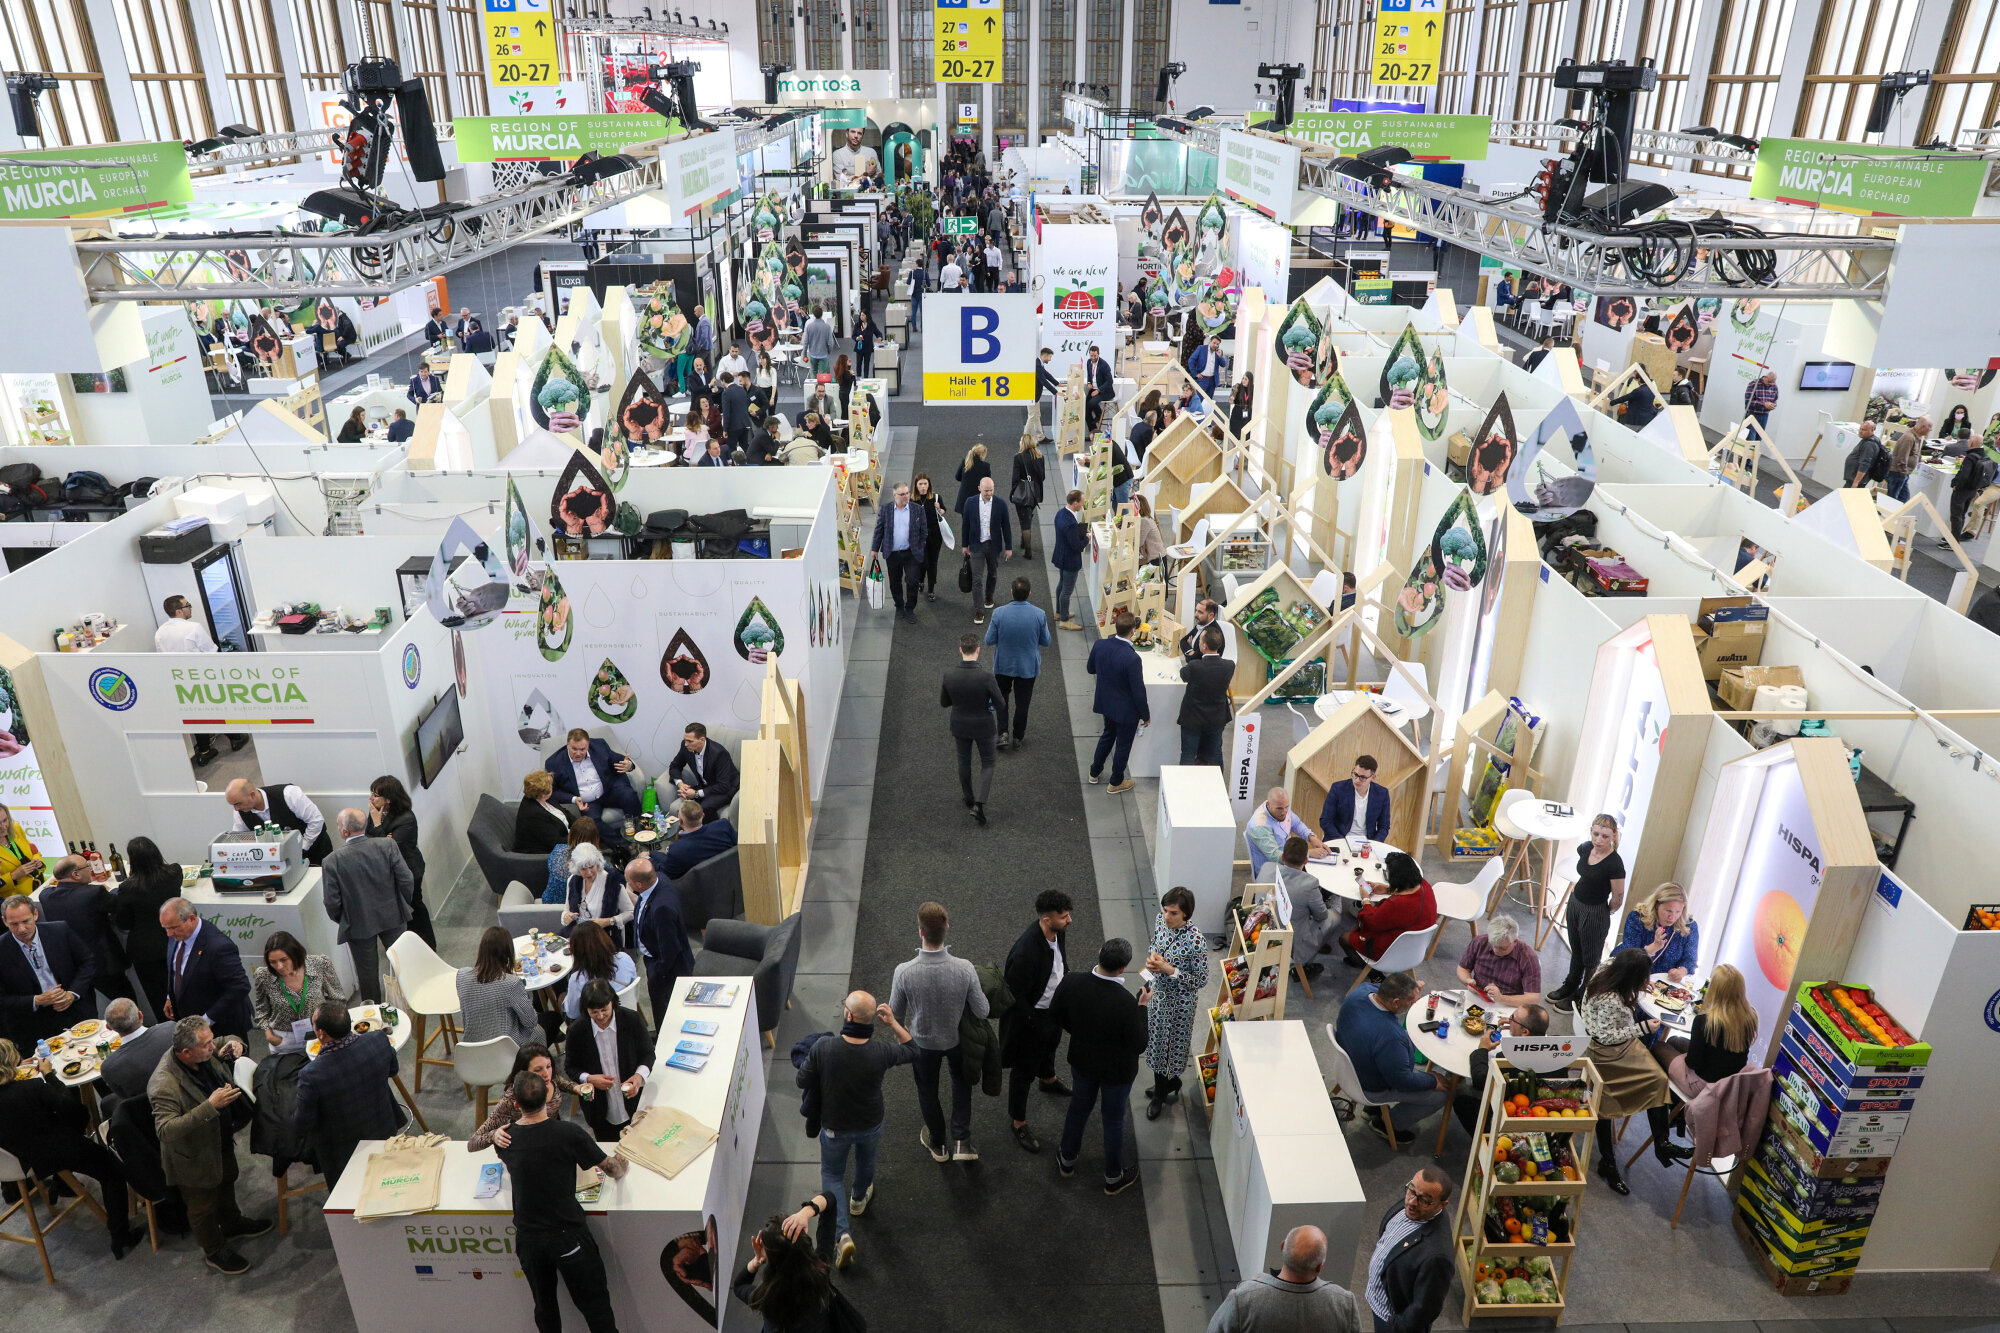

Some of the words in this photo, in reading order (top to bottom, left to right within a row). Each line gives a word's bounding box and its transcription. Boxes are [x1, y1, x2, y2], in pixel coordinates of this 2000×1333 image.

[493, 26, 507, 37] 27
[942, 22, 955, 33] 27
[1383, 25, 1397, 36] 27
[495, 44, 509, 55] 26
[942, 40, 955, 51] 26
[1381, 43, 1395, 54] 26
[498, 64, 550, 82] 20-27
[942, 60, 995, 77] 20-27
[1379, 63, 1432, 81] 20-27
[778, 79, 861, 92] montosa
[964, 106, 972, 116] B
[490, 122, 550, 132] REGION
[558, 121, 579, 131] OF
[587, 120, 663, 128] SUSTAINABLE
[1353, 119, 1373, 129] OF
[1382, 120, 1456, 129] SUSTAINABLE
[588, 131, 647, 139] EUROPEAN
[1381, 130, 1439, 138] EUROPEAN
[492, 134, 582, 151] MURCIA
[589, 141, 640, 149] ORCHAR
[0, 162, 63, 181] REGION
[1867, 158, 1944, 174] SUSTAINABLE
[99, 170, 149, 184] EUROPEAN
[1779, 165, 1853, 197] MURCIA
[1863, 173, 1922, 189] EUROPEAN
[3, 178, 98, 213] MURCIA
[103, 184, 147, 199] ORCHARD
[1860, 188, 1911, 204] ORCHARD
[1053, 266, 1065, 275] We
[1068, 267, 1082, 276] are
[1053, 312, 1104, 320] HORTIFRUT
[961, 307, 1001, 363] B
[949, 376, 977, 386] Halle
[981, 376, 1010, 397] 18
[949, 388, 967, 397] hall
[504, 618, 531, 630] What
[514, 630, 535, 641] gives
[1717, 653, 1748, 662] LAVAZZA
[171, 668, 260, 681] REGION
[272, 667, 301, 680] OF
[175, 682, 308, 704] MURCIA
[1239, 757, 1251, 800] HISPA
[25, 827, 53, 838] CIA
[1778, 823, 1820, 874] HISPA
[200, 912, 223, 926] at
[227, 913, 275, 928] water
[238, 930, 254, 940] us
[1808, 1004, 1844, 1046] Mercagrisa
[1513, 1044, 1559, 1052] HISPA
[1807, 1032, 1834, 1063] gregal
[1800, 1055, 1827, 1086] gregal
[1868, 1076, 1910, 1088] gregal
[1860, 1100, 1901, 1111] gregal
[1767, 1134, 1797, 1171] Adesur
[1762, 1155, 1791, 1191] Adesur
[381, 1176, 420, 1187] MURCIA
[404, 1225, 493, 1236] REGION
[505, 1225, 517, 1236] O
[1820, 1225, 1848, 1237] Bonasol
[407, 1237, 517, 1254] MURCI
[1813, 1245, 1841, 1256] Bonasol
[1809, 1265, 1836, 1277] Bonasol
